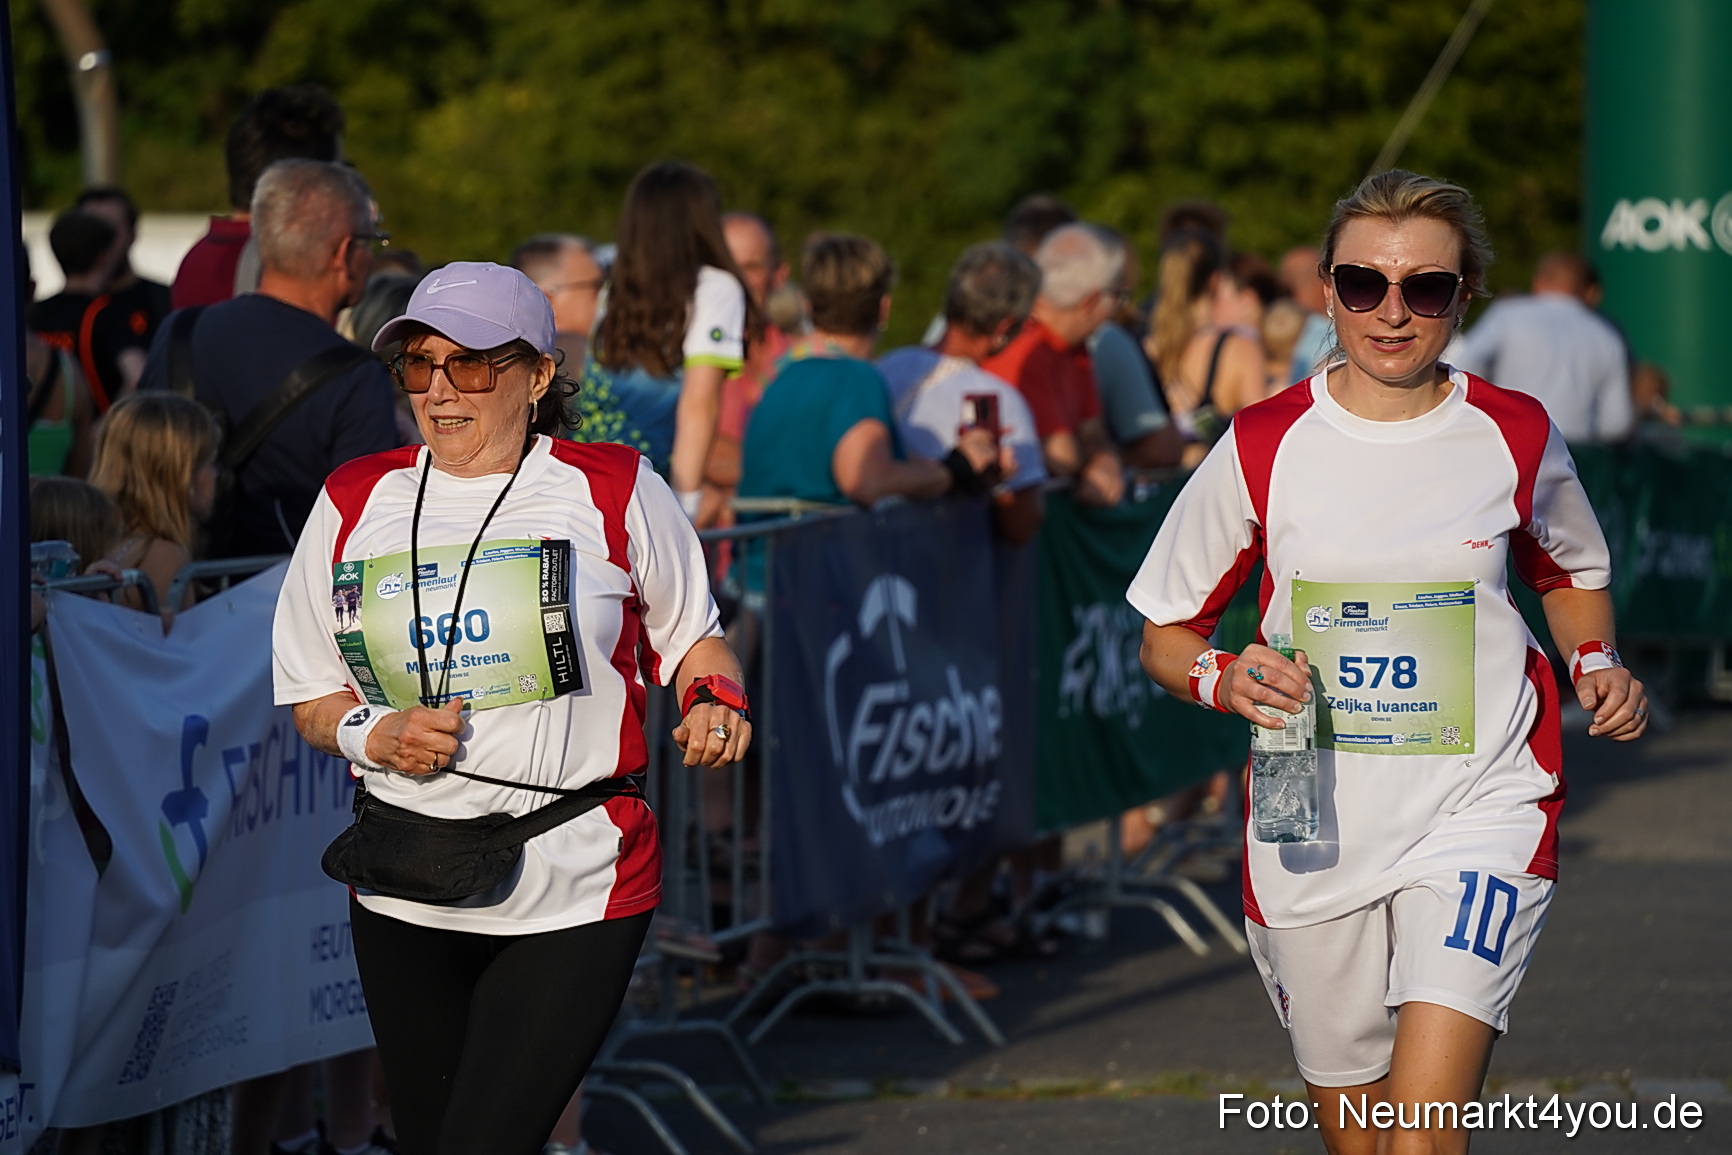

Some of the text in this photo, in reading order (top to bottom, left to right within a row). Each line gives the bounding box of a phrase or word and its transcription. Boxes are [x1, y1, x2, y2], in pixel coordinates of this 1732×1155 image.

[1600, 198, 1713, 252] AOK
[1472, 540, 1488, 549] DEHN
[337, 572, 359, 582] AOK
[405, 573, 457, 591] Fimenlauf
[425, 582, 457, 593] neumarkt
[542, 548, 550, 603] 20 % RABATT
[409, 609, 490, 649] 660
[1334, 617, 1389, 628] Firmenlauf
[405, 652, 511, 675] Mrina Strena
[552, 637, 569, 684] HILTL
[1338, 655, 1418, 690] 578
[1327, 696, 1438, 714] Zeljka Ivancan
[847, 664, 1003, 784] Fische
[1444, 870, 1519, 968] 10
[310, 920, 351, 964] HEUT
[309, 977, 366, 1025] MORGE
